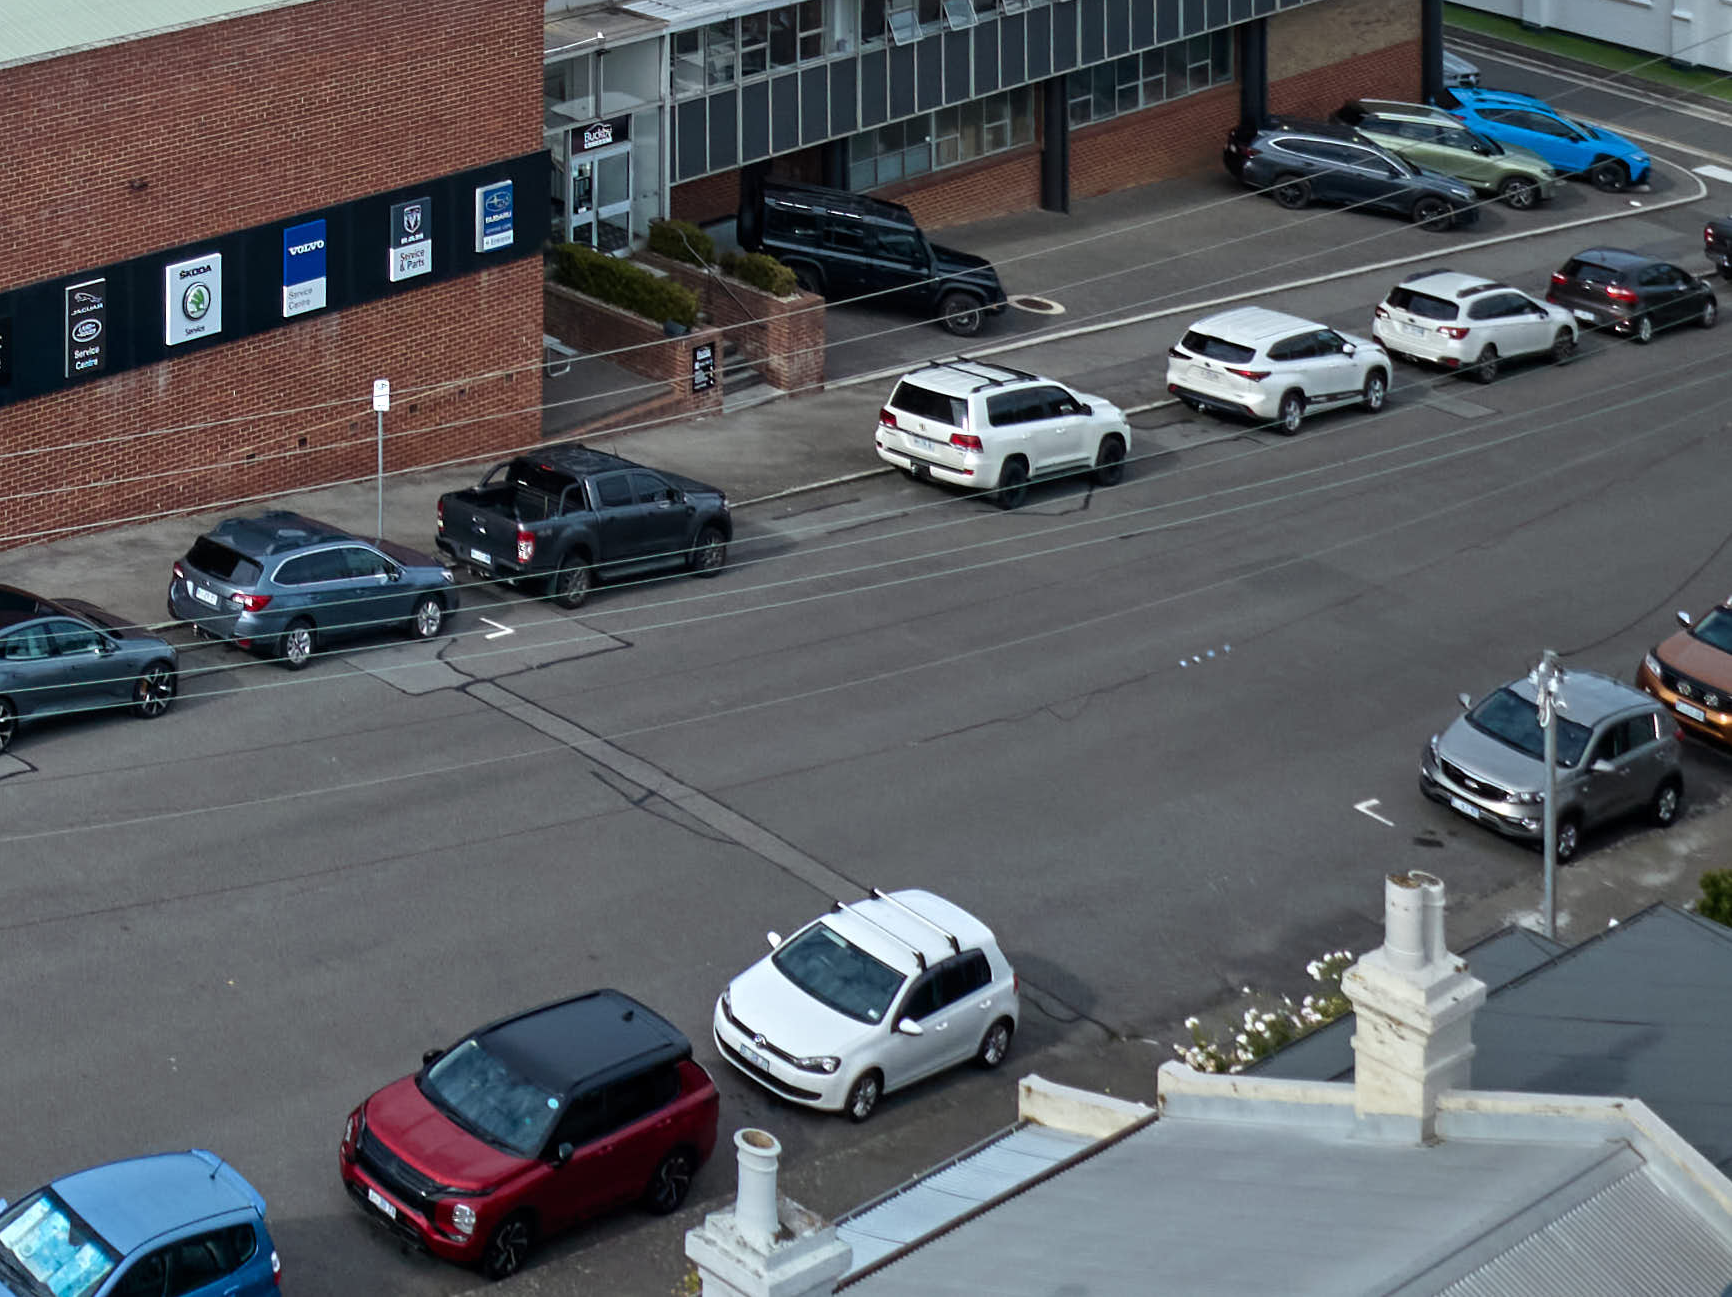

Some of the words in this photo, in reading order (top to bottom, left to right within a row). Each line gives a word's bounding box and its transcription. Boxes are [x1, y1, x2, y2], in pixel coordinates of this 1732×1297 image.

[288, 240, 325, 256] VOLVO
[400, 249, 424, 261] Service
[407, 258, 424, 270] Parts
[288, 287, 313, 300] Service
[185, 324, 206, 337] Service
[74, 346, 100, 359] Service
